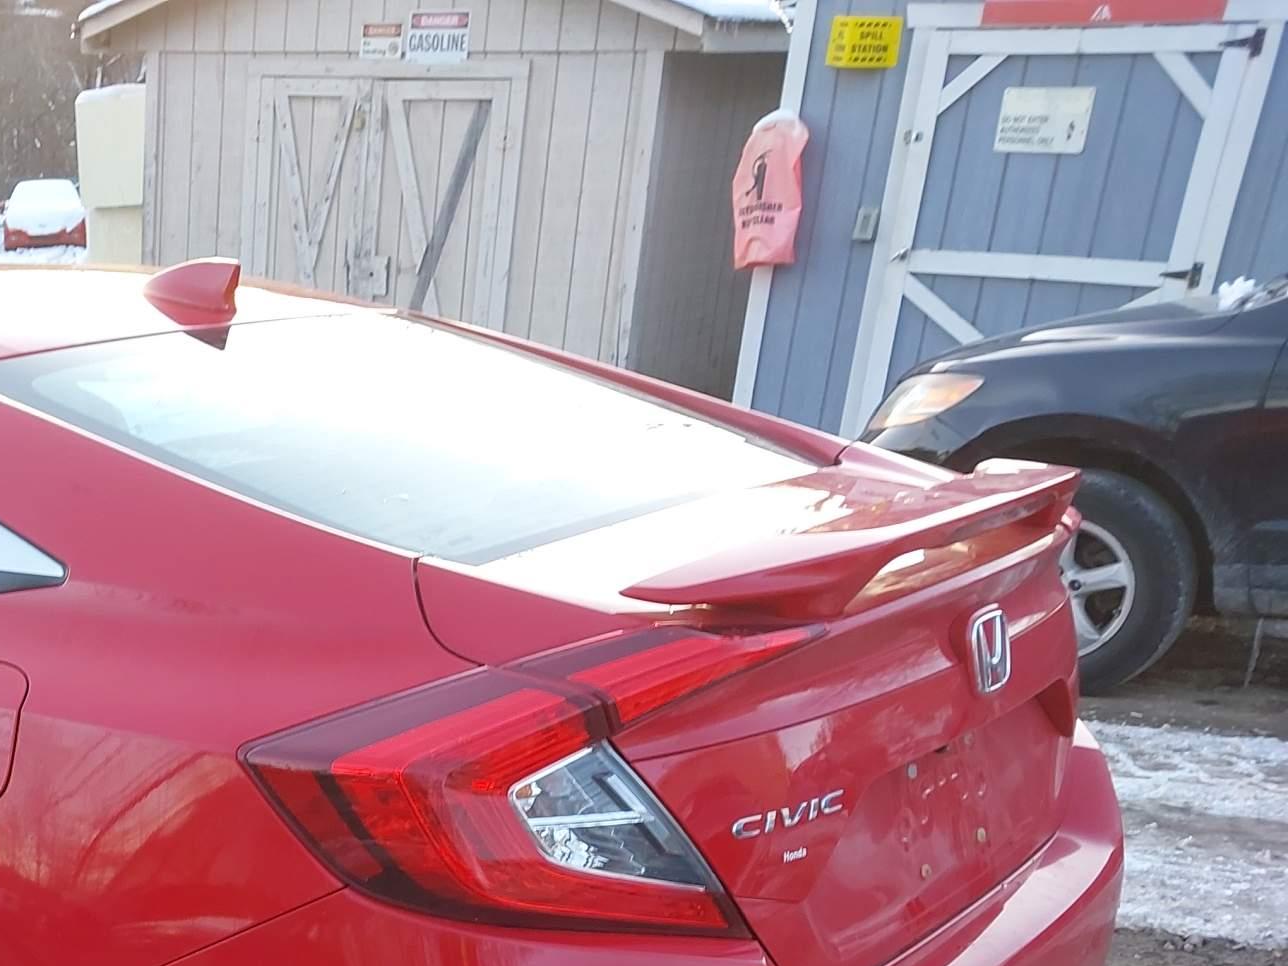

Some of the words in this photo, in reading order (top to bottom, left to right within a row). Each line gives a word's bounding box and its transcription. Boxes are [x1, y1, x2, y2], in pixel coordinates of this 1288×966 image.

[421, 15, 458, 26] DANGER
[409, 32, 466, 52] GASOLINE
[859, 31, 883, 40] SPILL
[850, 44, 889, 53] STATION
[732, 789, 845, 839] CIVIC
[783, 846, 807, 863] Honda
